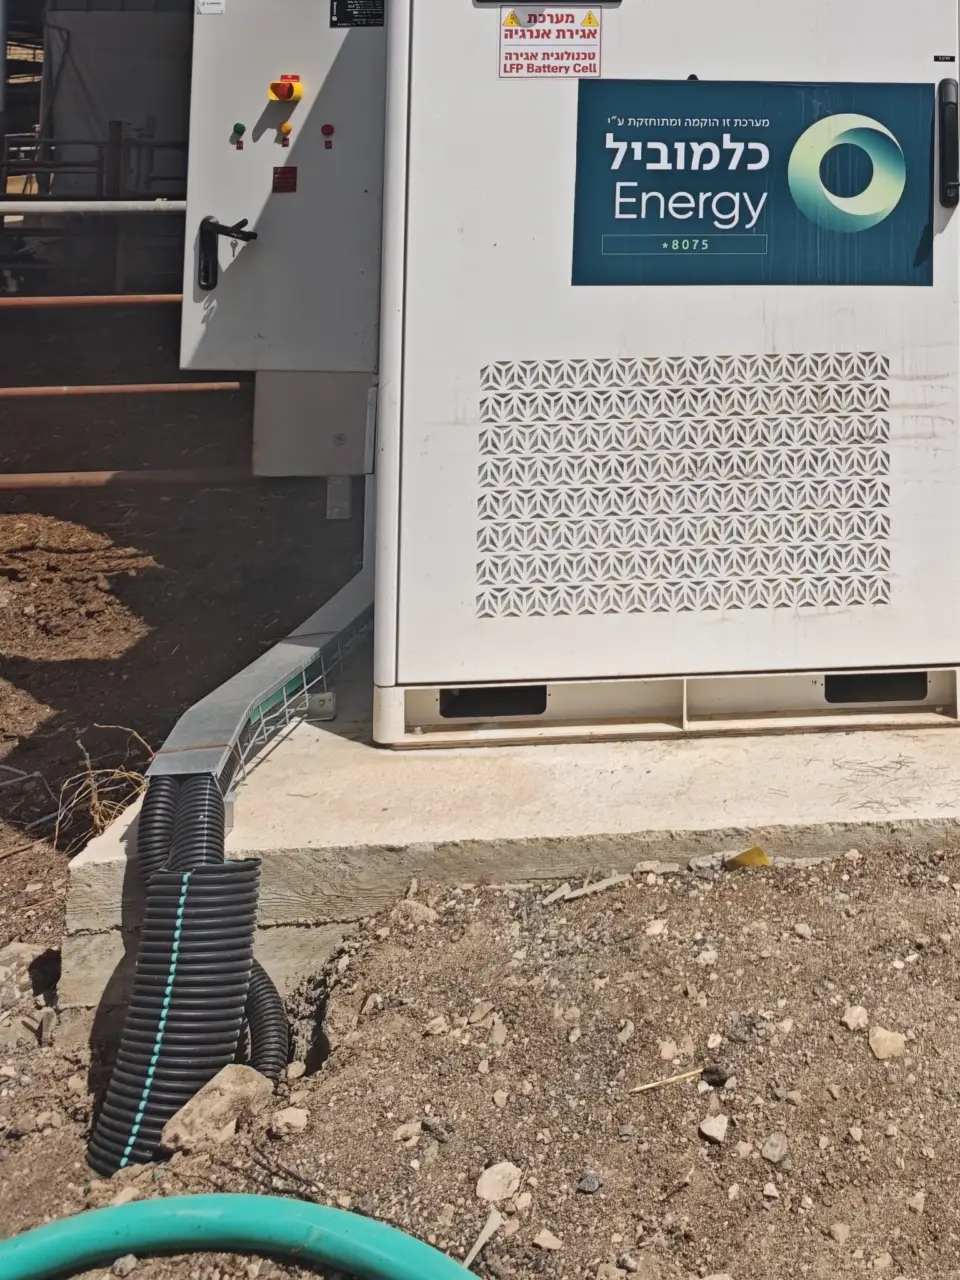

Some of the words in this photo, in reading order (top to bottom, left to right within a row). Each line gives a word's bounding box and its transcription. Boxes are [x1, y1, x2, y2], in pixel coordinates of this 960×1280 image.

[527, 13, 575, 24] מערכת
[504, 28, 552, 39] אנרגיה
[555, 28, 598, 39] אגירת
[504, 52, 539, 61] אגירה
[541, 51, 596, 61] טכנולוגית
[503, 63, 524, 73] LFP
[526, 63, 570, 74] Battery
[573, 63, 597, 73] Cell
[627, 117, 681, 129] ומתוחזקת
[684, 118, 719, 129] הוקמה
[722, 118, 731, 127] זו
[733, 118, 770, 127] מערכת
[605, 132, 770, 171] כלמוביל
[614, 181, 768, 230] Energy
